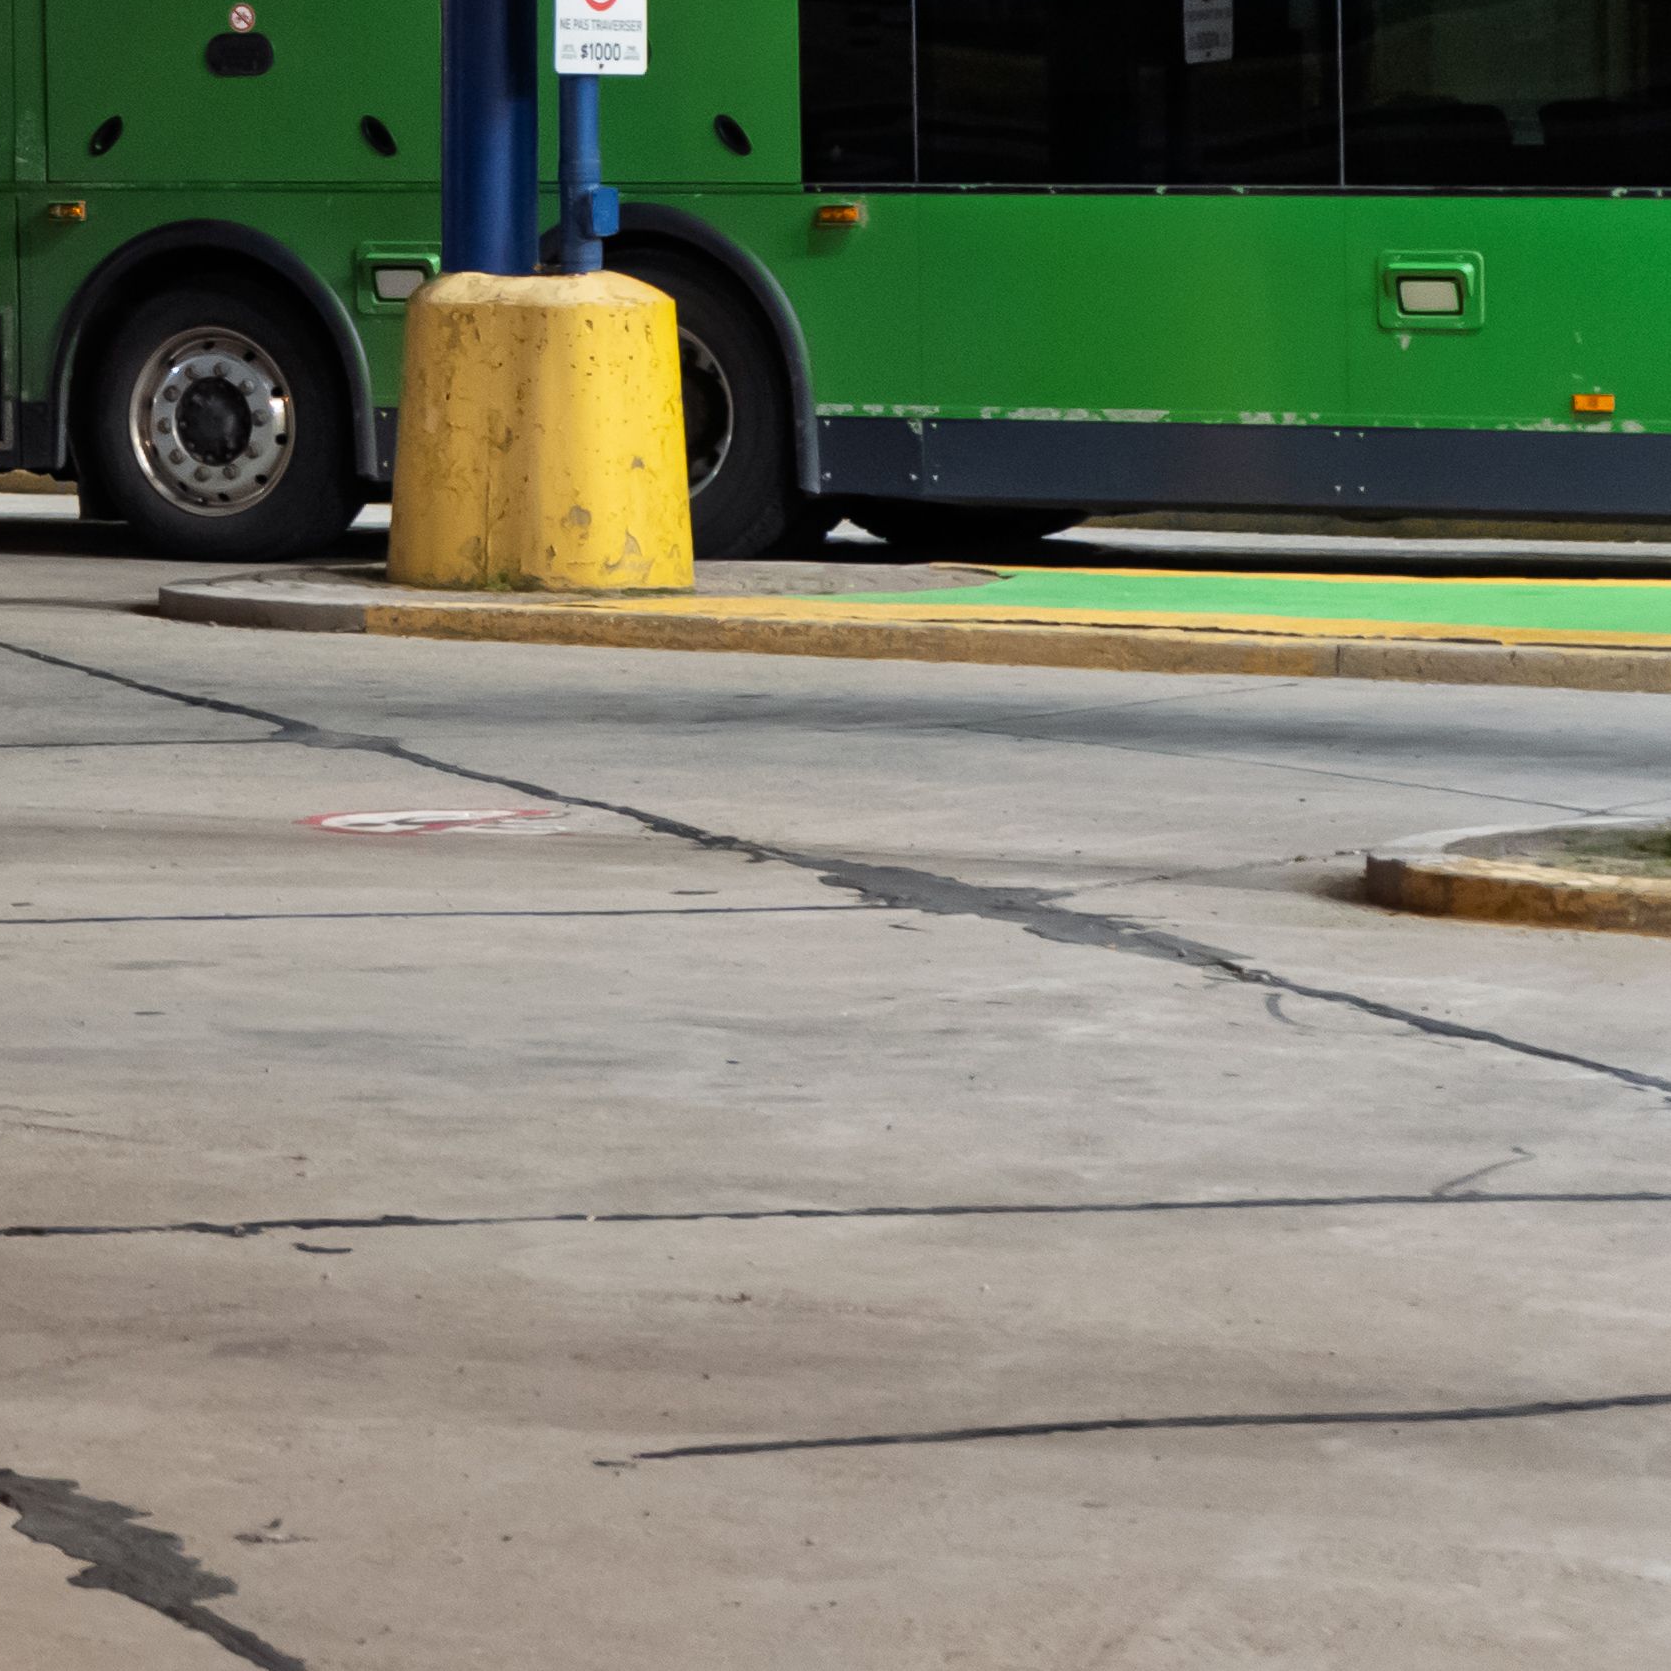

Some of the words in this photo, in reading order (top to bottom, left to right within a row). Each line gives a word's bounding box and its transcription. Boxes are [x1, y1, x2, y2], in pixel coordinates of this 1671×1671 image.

[560, 18, 571, 30] NE
[573, 18, 590, 31] PAS
[591, 19, 642, 32] TRAVERSER
[580, 42, 622, 61] $1000
